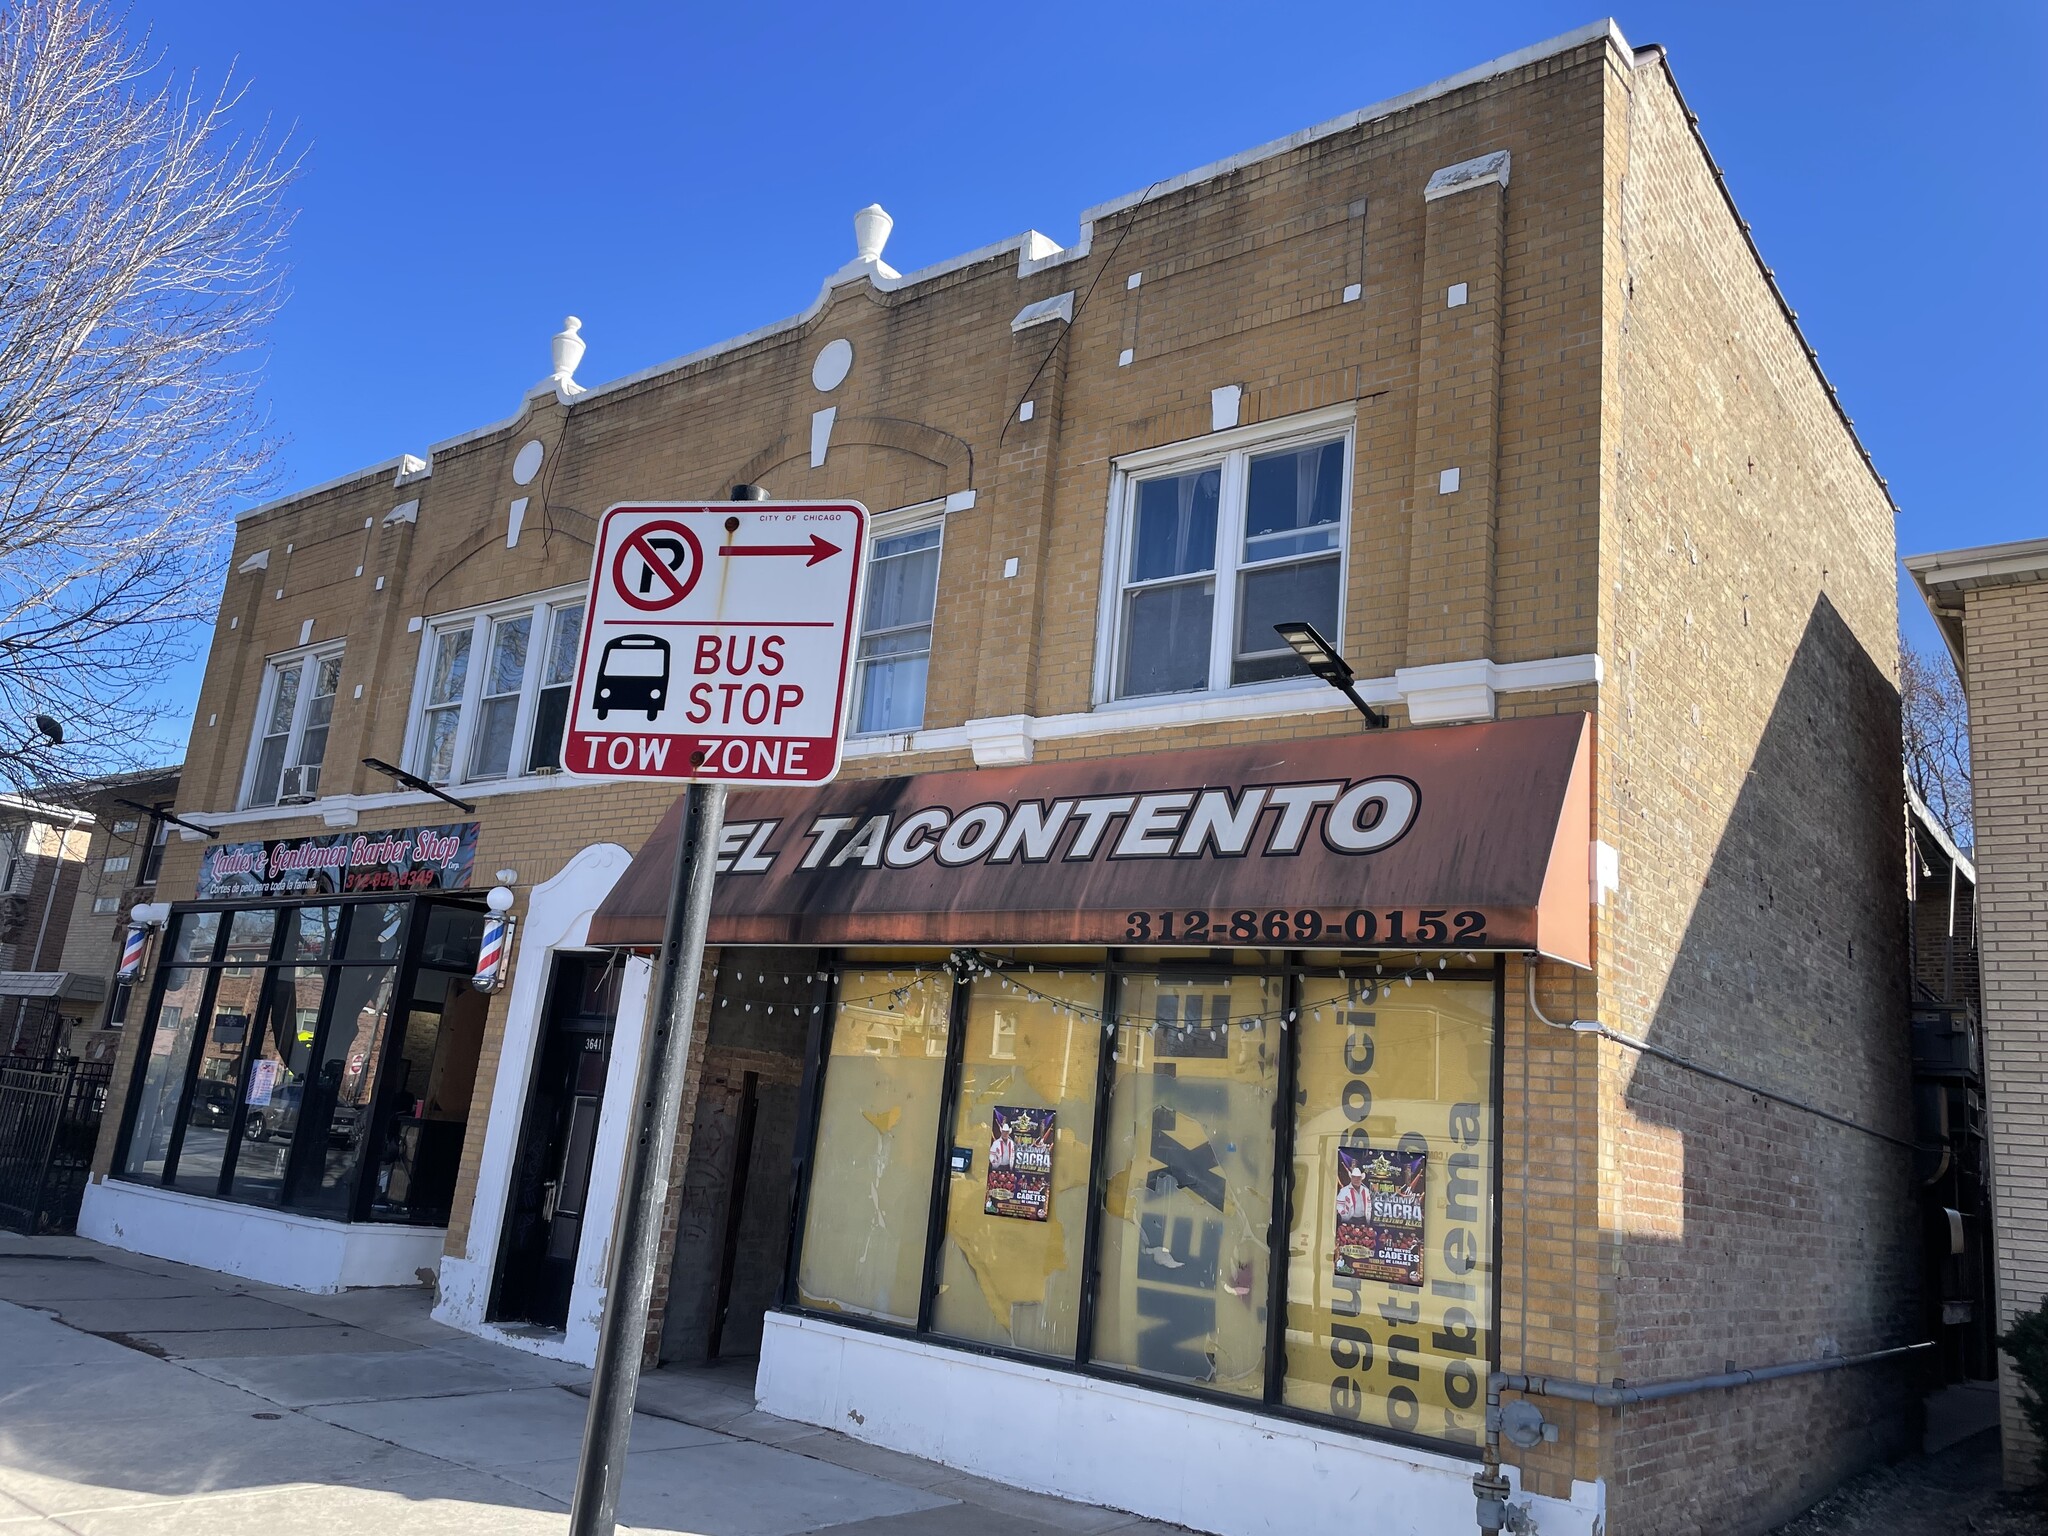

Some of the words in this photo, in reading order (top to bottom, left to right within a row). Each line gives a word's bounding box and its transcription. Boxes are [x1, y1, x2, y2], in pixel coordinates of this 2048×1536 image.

[759, 514, 779, 522] CITY
[785, 514, 797, 522] OF
[693, 635, 786, 676] BUS
[685, 682, 804, 725] STOP
[583, 736, 672, 771] TOW
[695, 739, 810, 775] ZONE
[715, 819, 784, 875] EL
[793, 774, 1422, 874] TACONTENTO
[211, 848, 254, 883] Ladies
[255, 850, 269, 872] &
[269, 842, 347, 878] Gentlemen
[350, 835, 411, 867] Barber
[413, 830, 460, 869] Shop
[210, 884, 231, 894] Cortes
[231, 883, 240, 893] de
[240, 883, 253, 895] pelo
[253, 883, 269, 894] para
[269, 880, 285, 891] toda
[286, 880, 294, 890] la
[294, 878, 317, 890] familia
[1126, 909, 1488, 945] 312-869-0152
[585, 1038, 602, 1050] 3641
[1016, 1152, 1051, 1167] SACRA
[1136, 950, 1234, 1381] NEXTEL
[1017, 1192, 1046, 1202] CADETES
[1374, 1202, 1422, 1221] SACRA
[1378, 1251, 1420, 1263] CADETES
